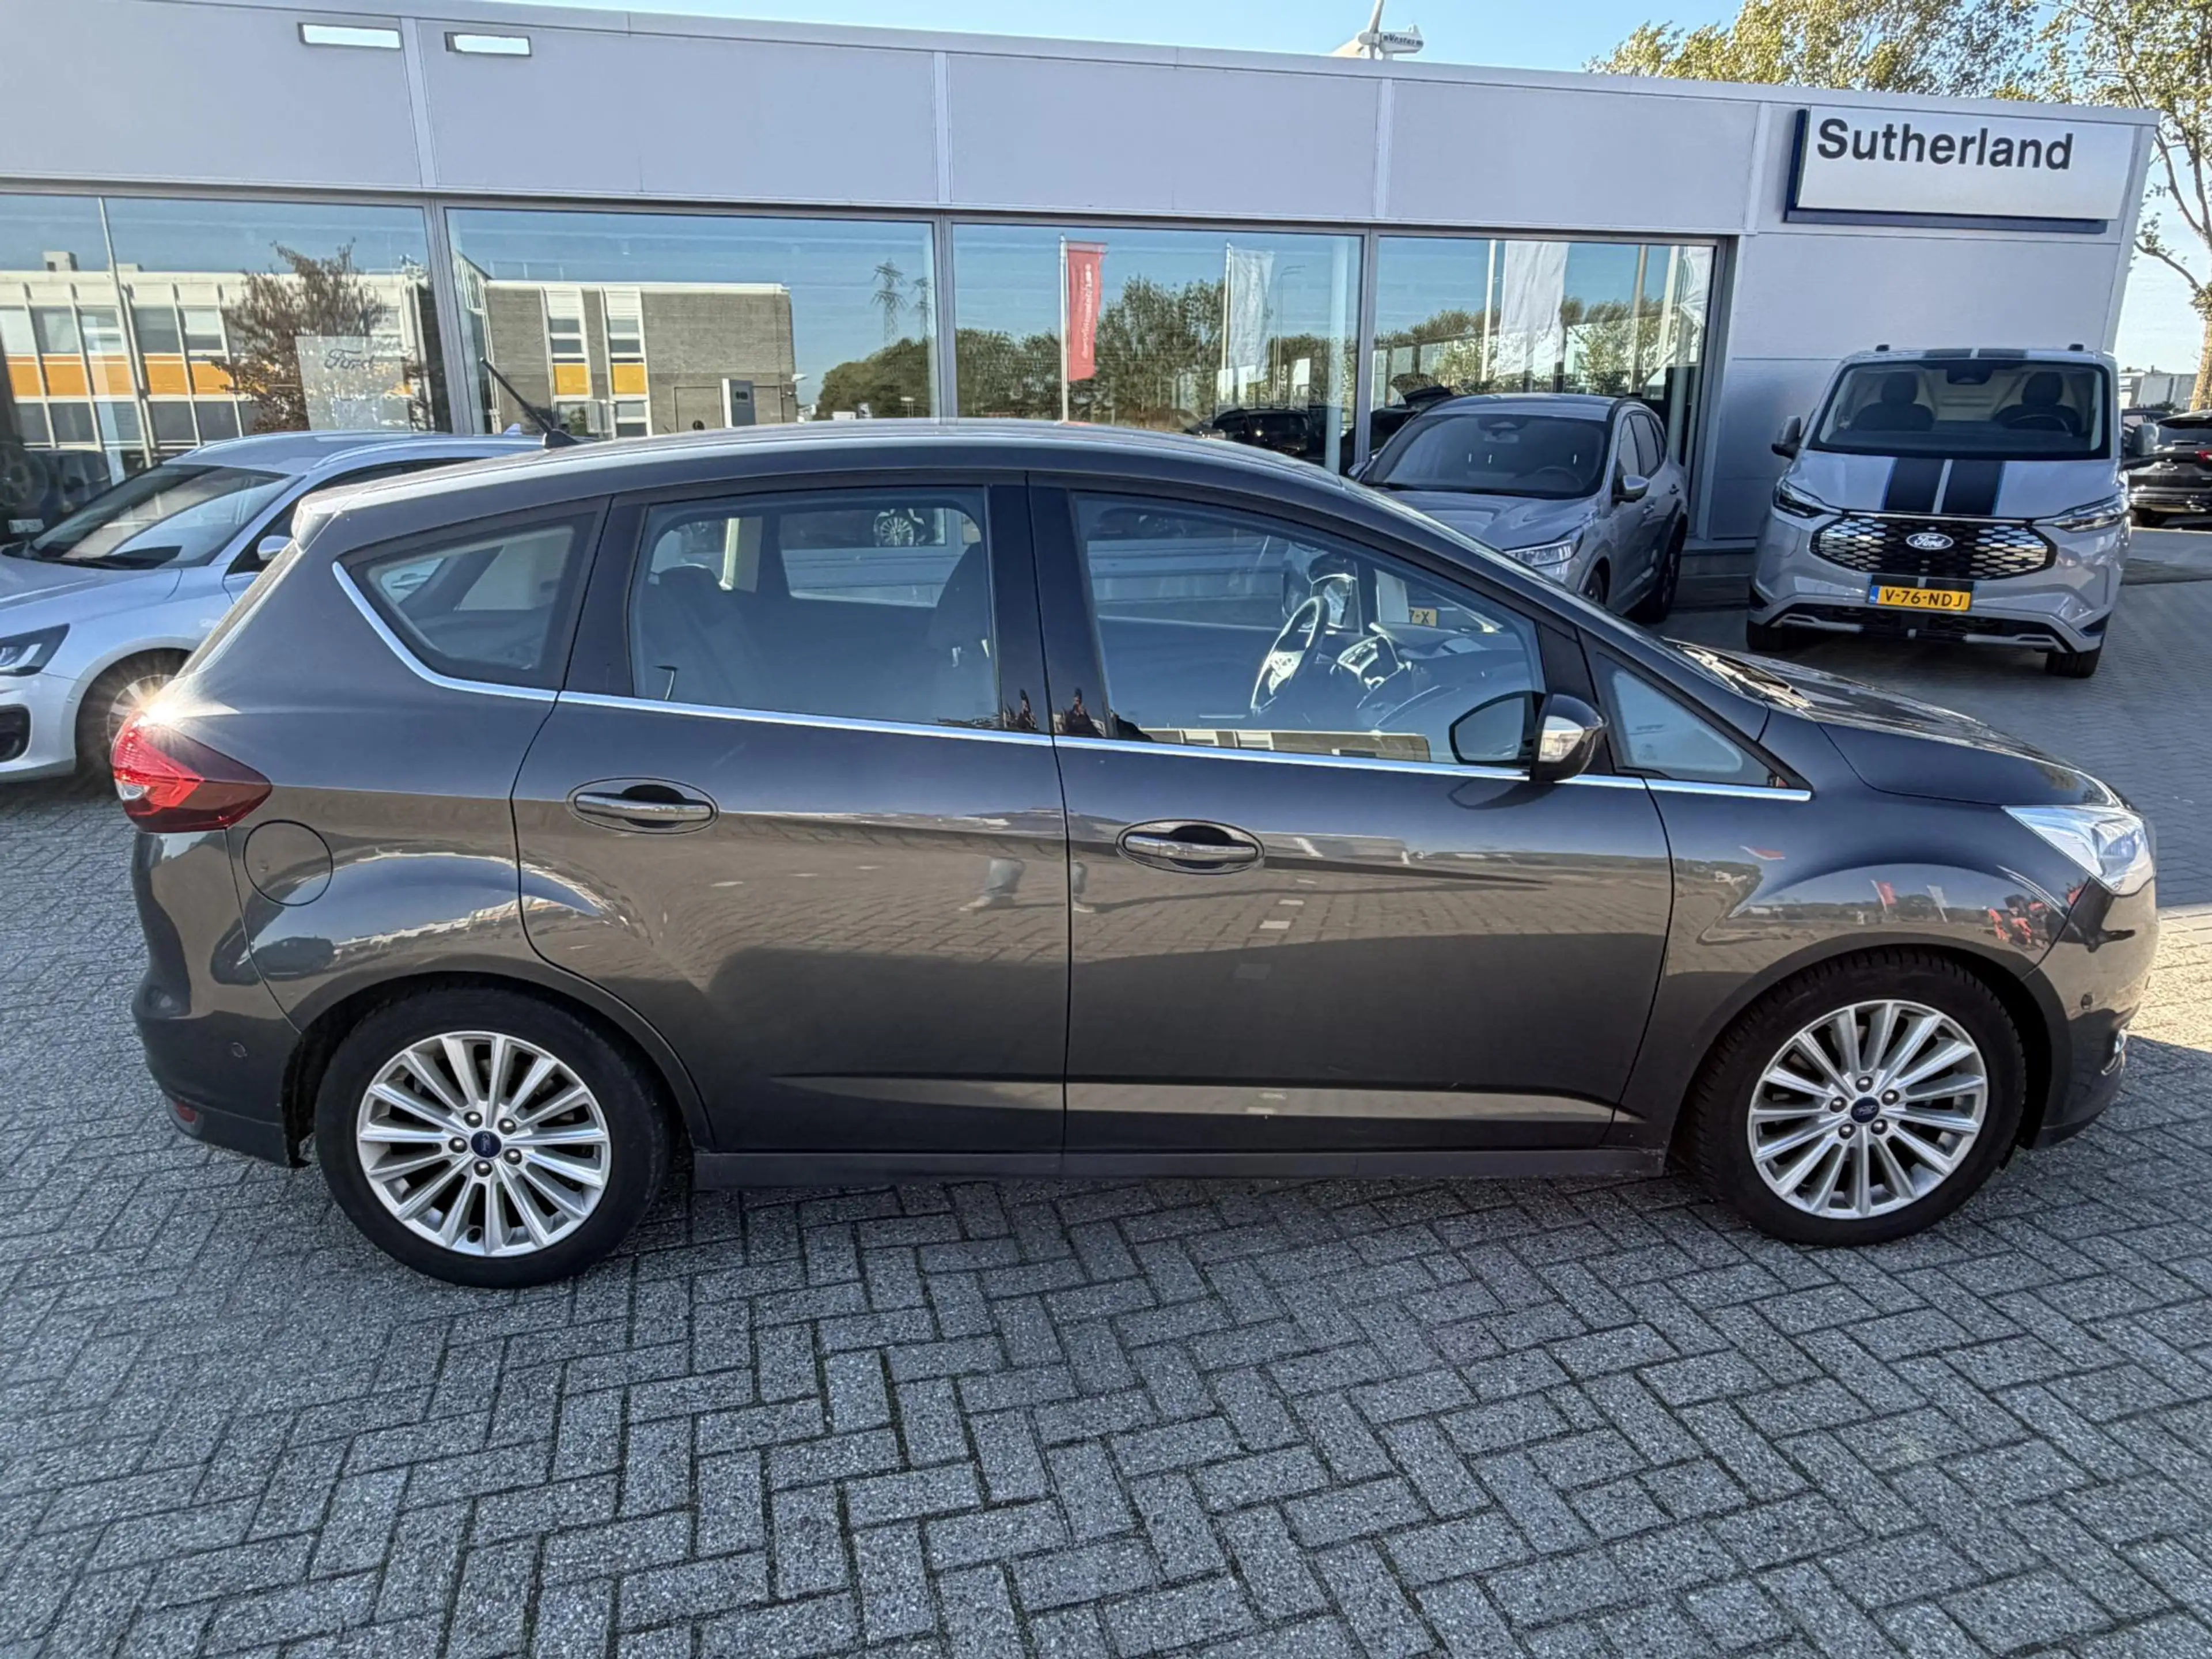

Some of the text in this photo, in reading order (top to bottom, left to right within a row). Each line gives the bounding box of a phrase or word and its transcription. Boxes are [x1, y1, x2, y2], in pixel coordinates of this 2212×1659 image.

[1817, 118, 2073, 170] Sutherland
[324, 348, 374, 370] Ford
[1914, 535, 1946, 547] Ford
[1885, 589, 1963, 607] V-76-NDJ
